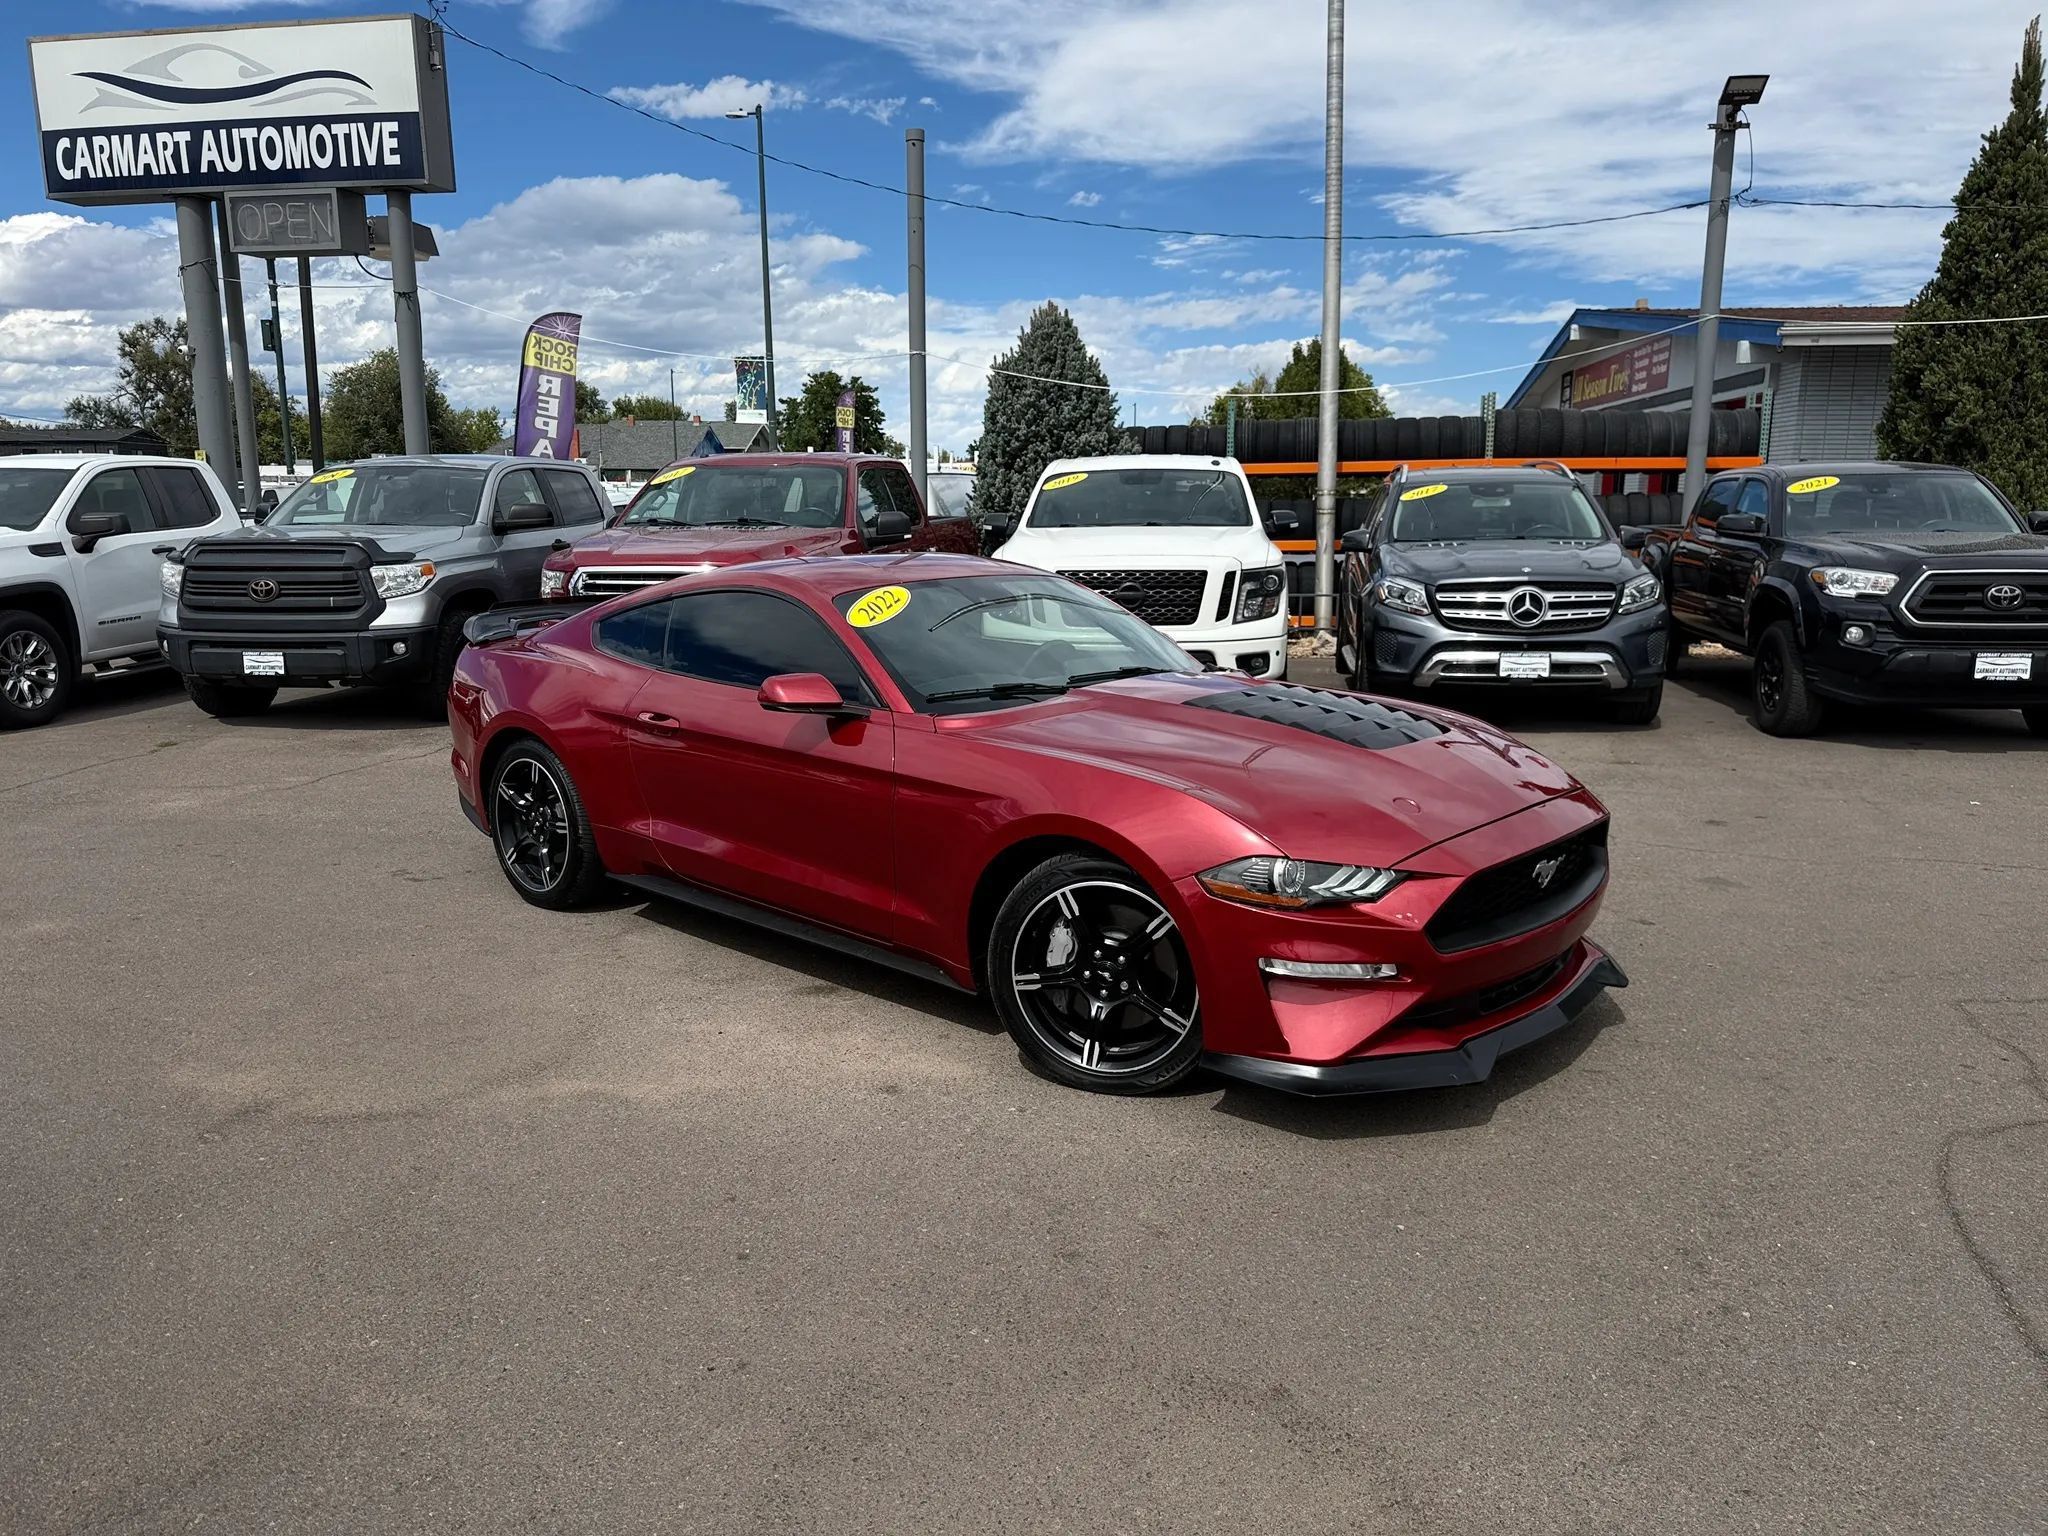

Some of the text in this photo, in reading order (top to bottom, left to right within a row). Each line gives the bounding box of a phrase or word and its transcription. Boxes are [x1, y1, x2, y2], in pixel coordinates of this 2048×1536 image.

[55, 121, 401, 180] CARMART AUTOMOTIVE
[236, 201, 333, 241] OPEN
[1410, 486, 1439, 498] 2017
[1799, 478, 1828, 491] 2021
[858, 590, 901, 622] 2022
[98, 615, 142, 625] SIERRA
